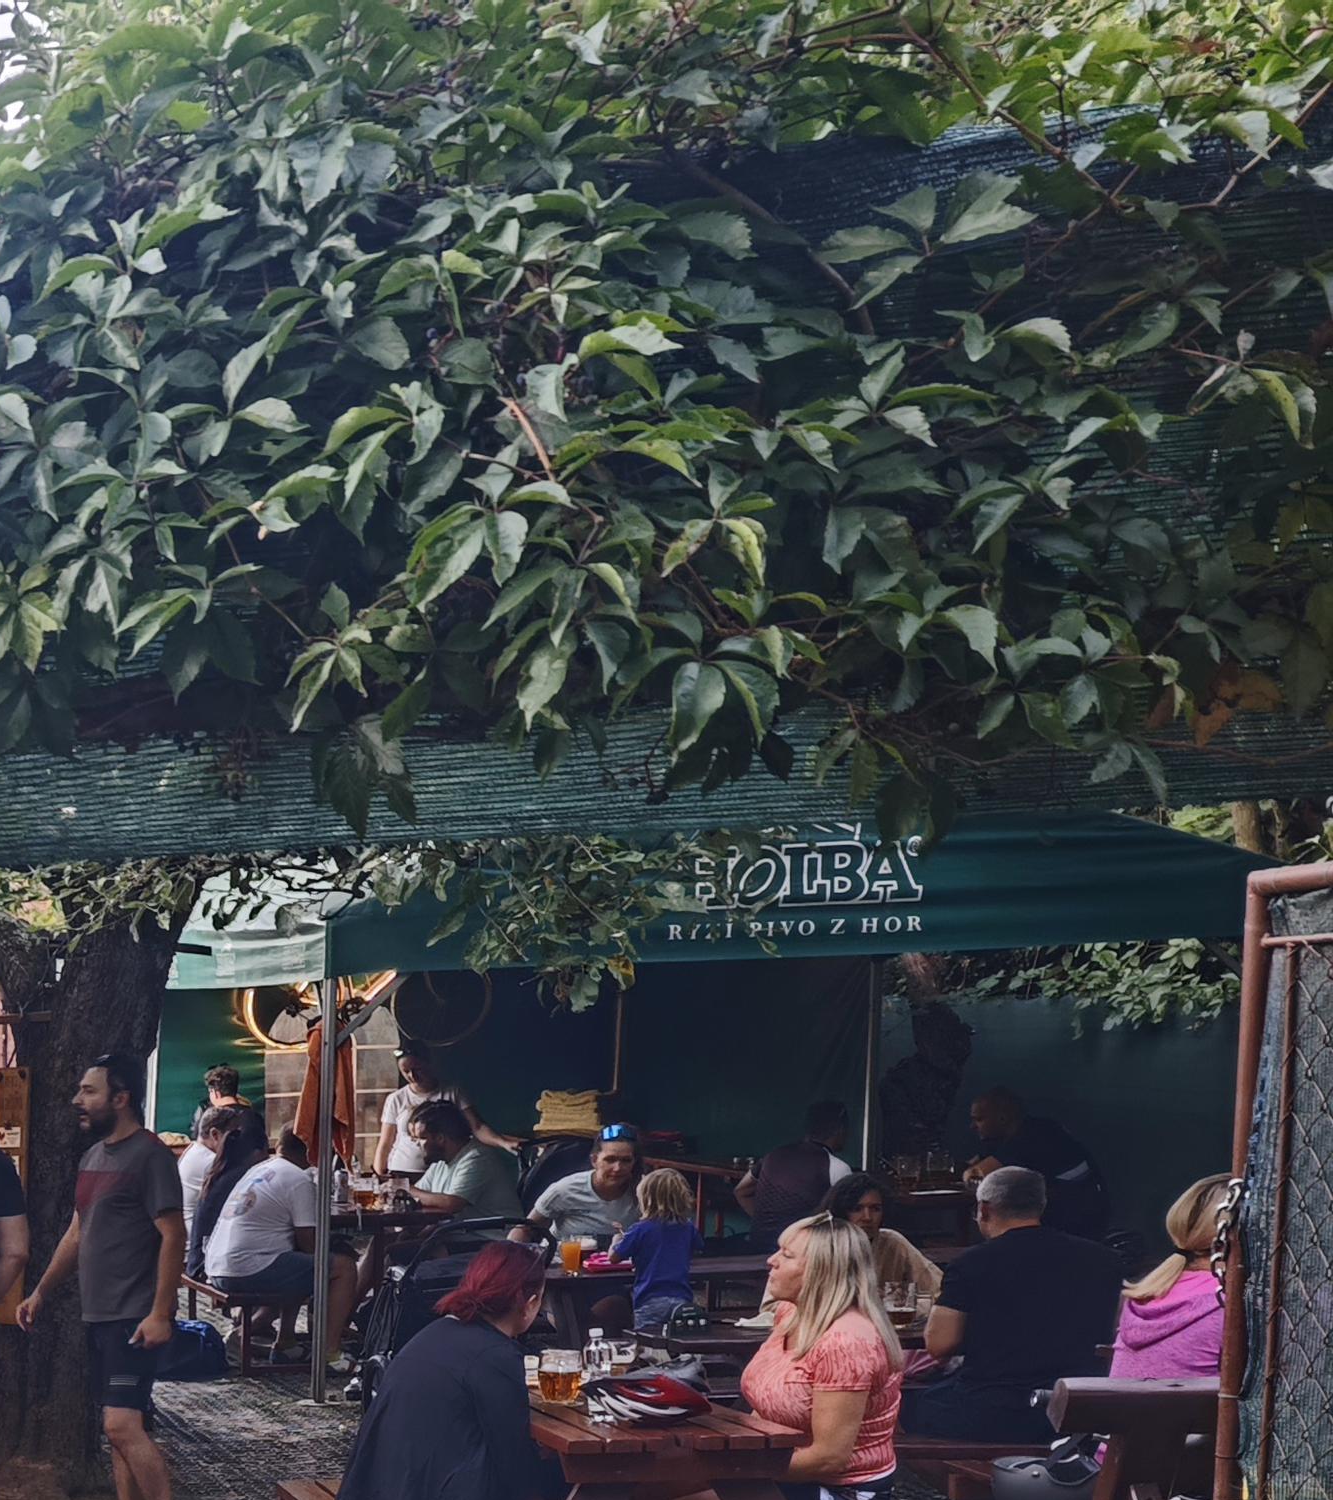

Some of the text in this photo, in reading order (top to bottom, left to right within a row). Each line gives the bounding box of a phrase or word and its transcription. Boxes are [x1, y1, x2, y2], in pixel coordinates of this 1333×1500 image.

[749, 918, 815, 938] PIVO
[830, 918, 845, 935] Z
[861, 915, 923, 934] HOR
